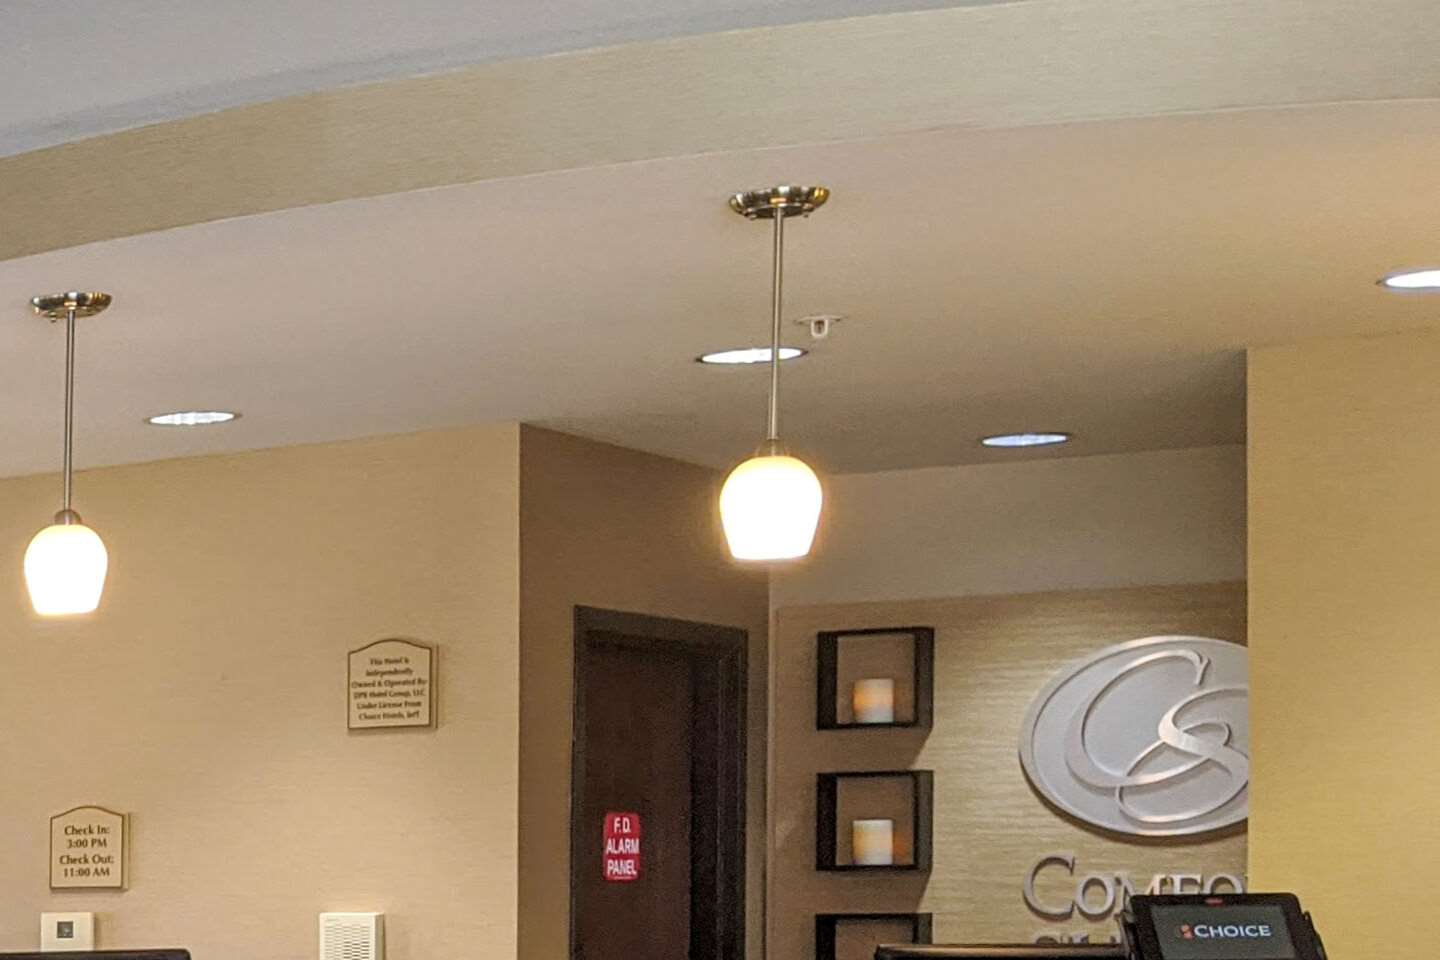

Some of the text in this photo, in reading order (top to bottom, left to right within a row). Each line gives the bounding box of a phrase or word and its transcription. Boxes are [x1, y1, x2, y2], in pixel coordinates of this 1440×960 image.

[351, 680, 376, 688] Owned
[384, 678, 415, 688] Operated
[64, 825, 93, 836] Check
[67, 838, 107, 849] 3:00 PM
[606, 838, 640, 854] ALARM
[59, 854, 89, 865] Check
[63, 866, 110, 878] 11:00 AM
[607, 859, 637, 876] PANEL
[1193, 924, 1272, 938] CHOICE
